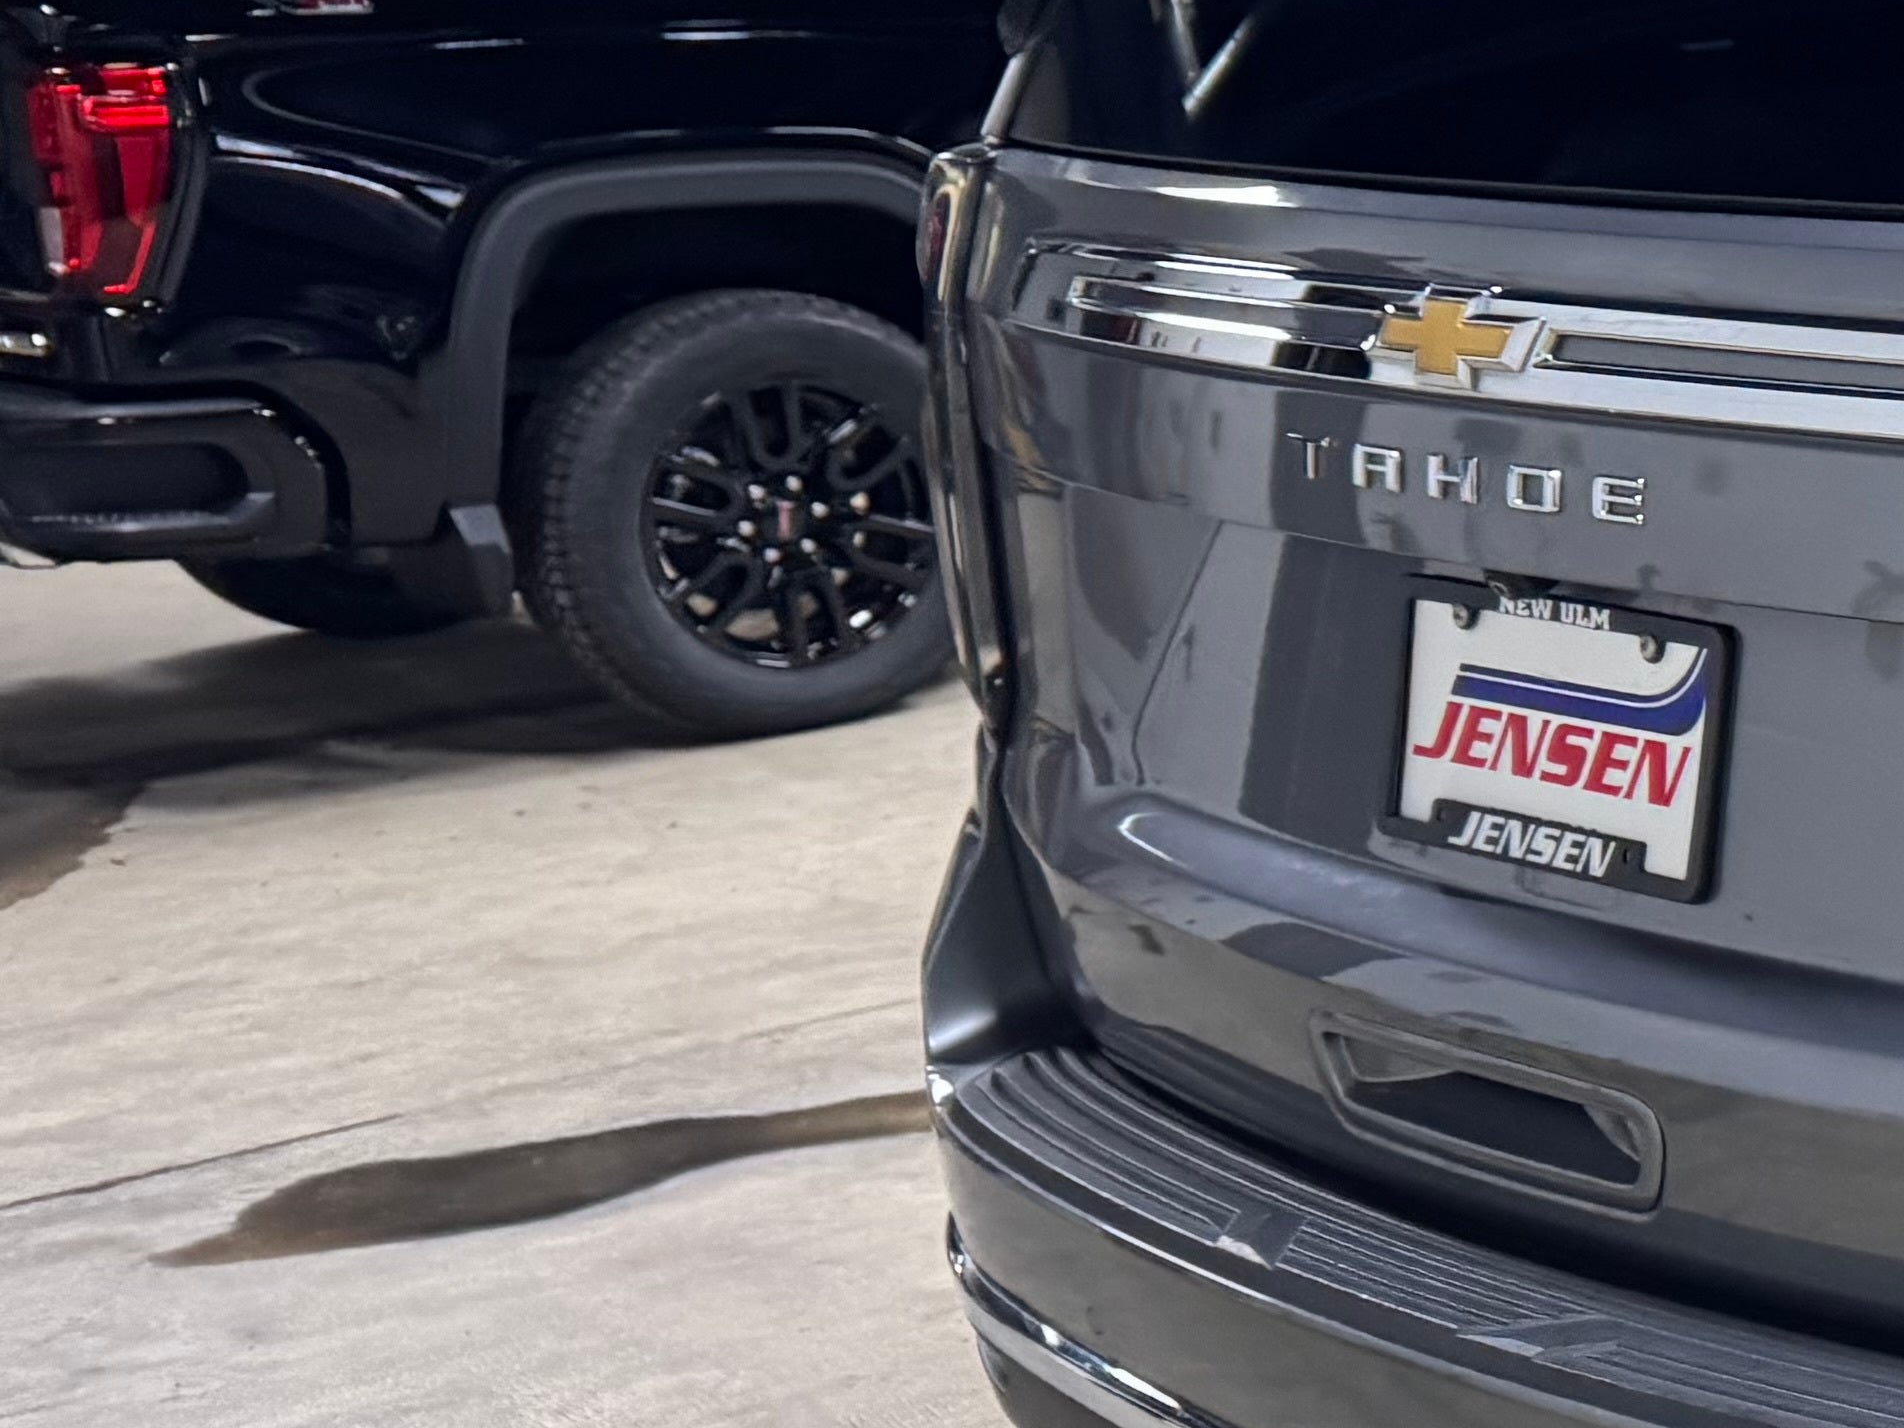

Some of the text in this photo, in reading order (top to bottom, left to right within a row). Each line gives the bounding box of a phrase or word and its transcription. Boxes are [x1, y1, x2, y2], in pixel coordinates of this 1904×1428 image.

[1285, 431, 1645, 525] TAHOE
[1499, 596, 1611, 631] NEW ULM
[1412, 700, 1692, 808] JENSEN
[1447, 810, 1616, 878] JENSEN
